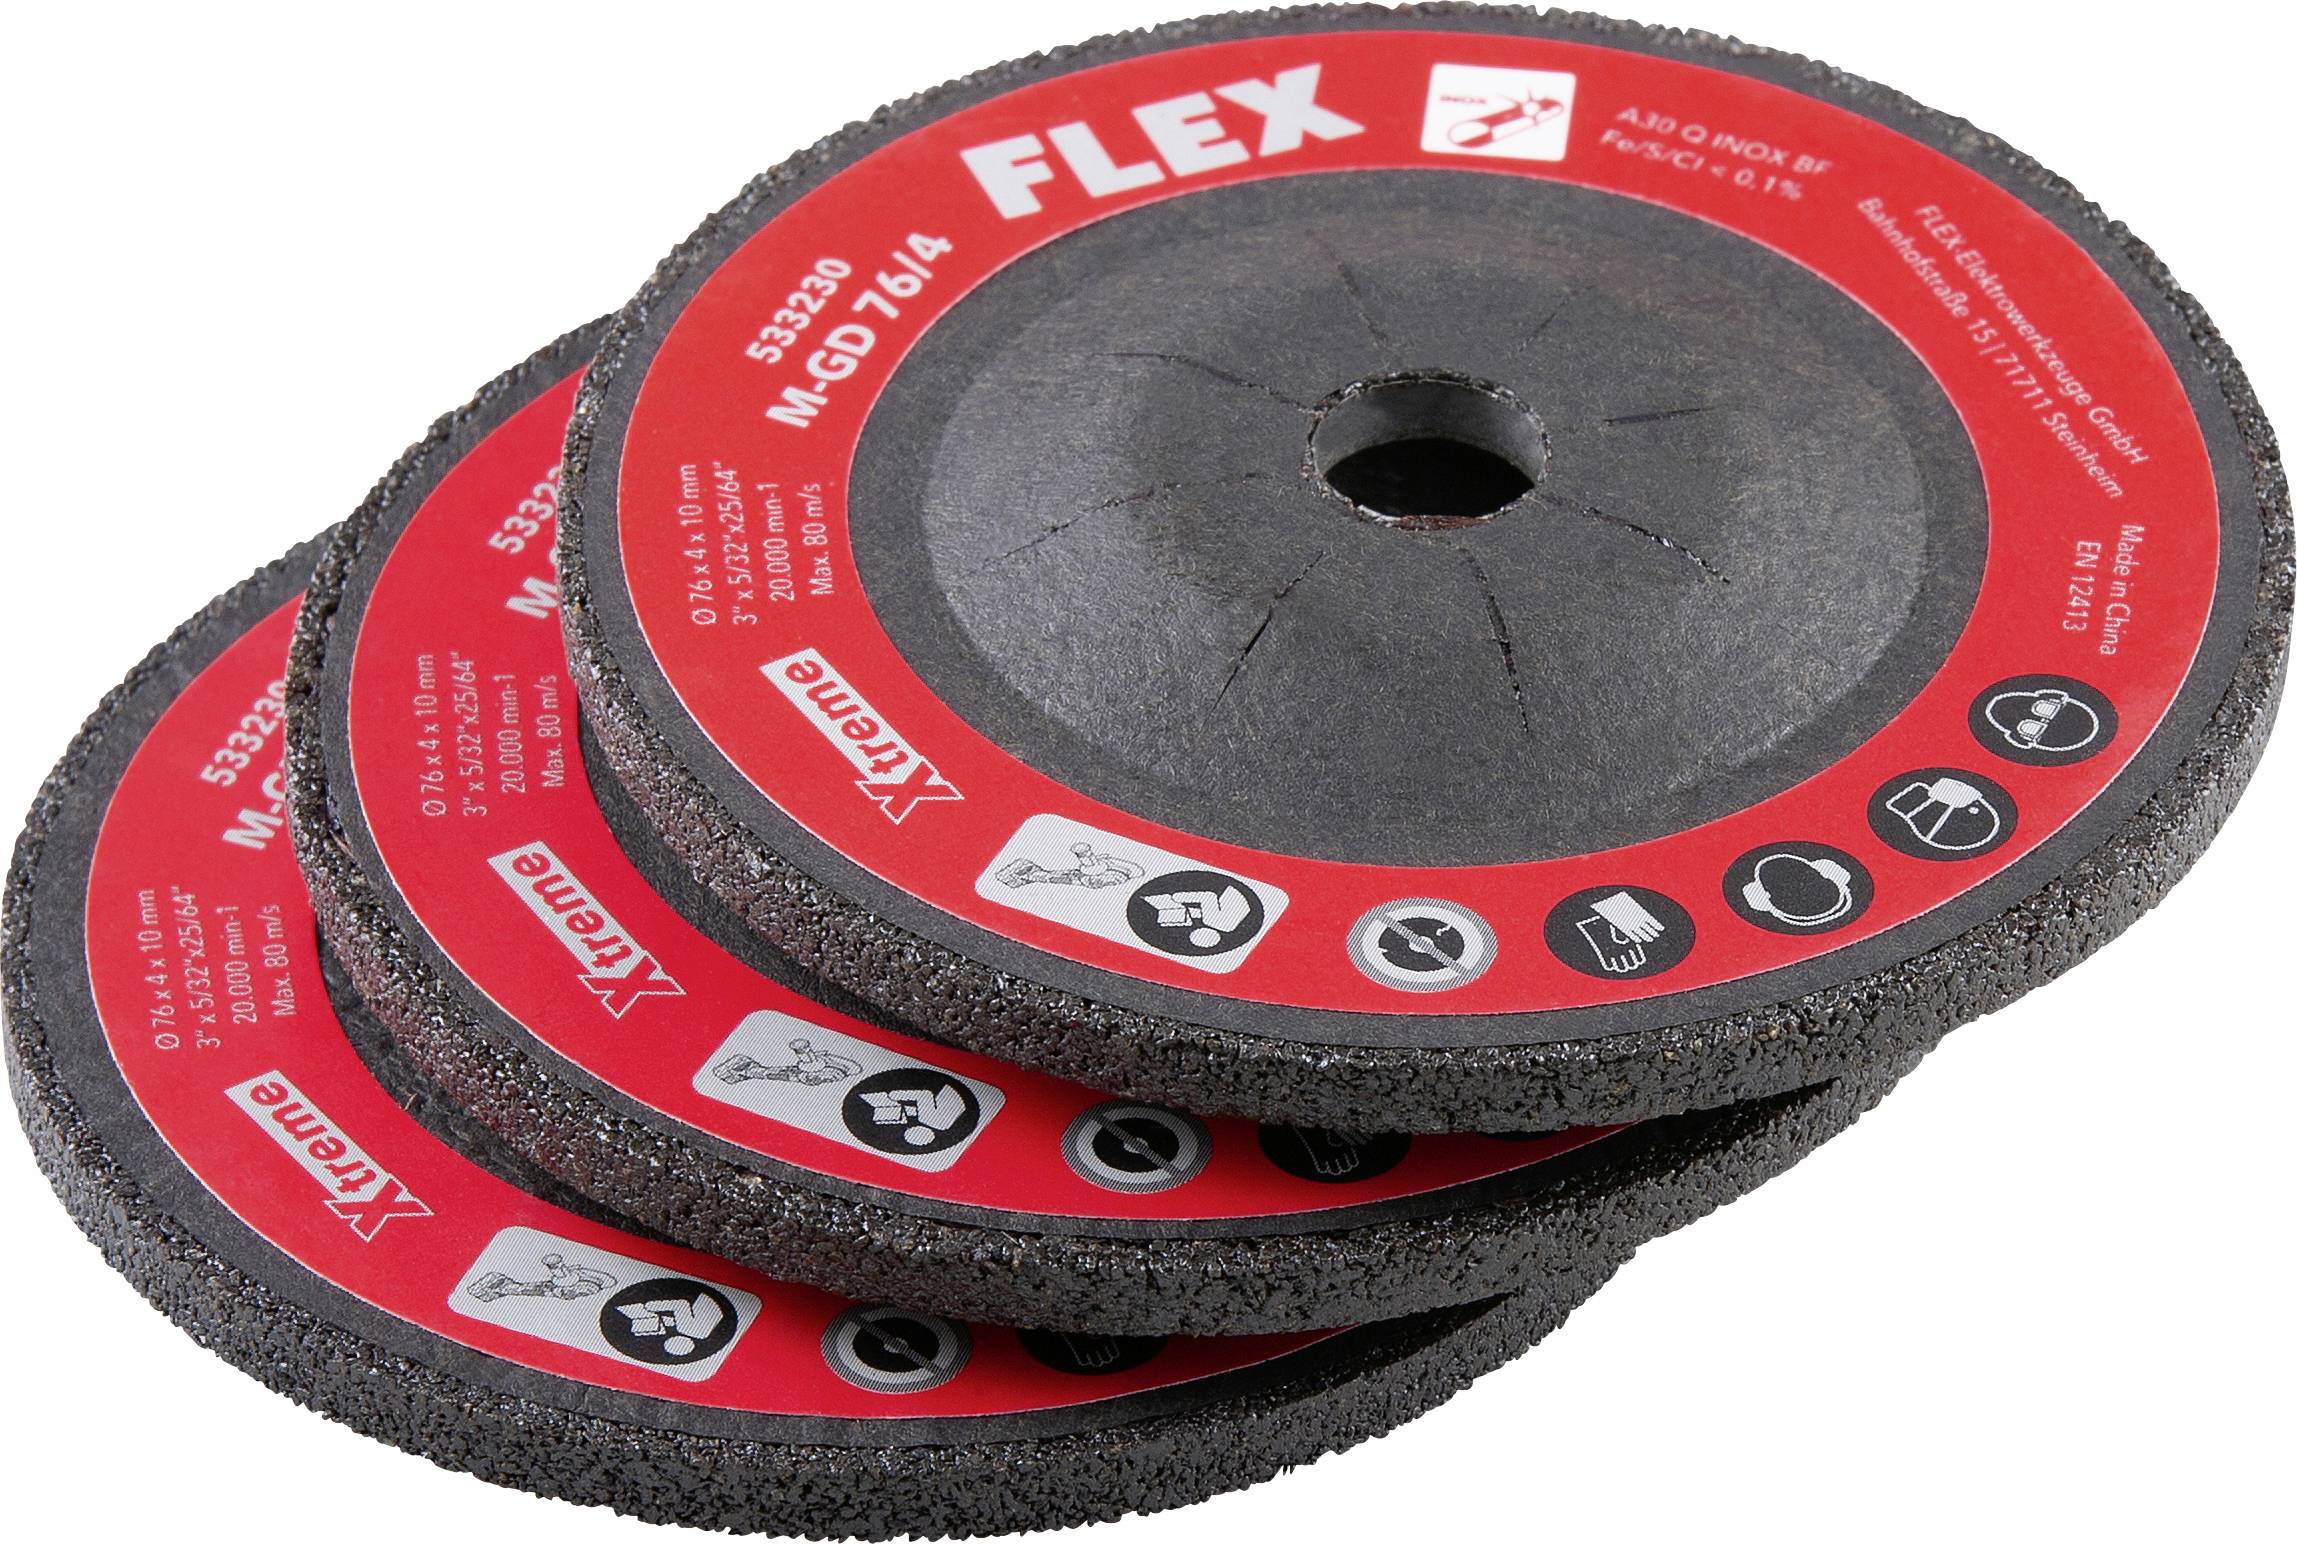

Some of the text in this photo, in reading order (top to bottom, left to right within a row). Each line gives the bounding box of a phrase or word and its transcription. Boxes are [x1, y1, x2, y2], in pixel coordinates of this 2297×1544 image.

[959, 62, 1366, 220] FLEX
[1615, 106, 1833, 176] A30 Q INOX BF
[744, 257, 853, 365] 533230
[765, 232, 954, 429] M-GD 76/4
[1856, 196, 1970, 318] Bahnhofstraße
[1967, 318, 1999, 344] 15
[1993, 351, 2054, 410] 71711
[2041, 411, 2124, 499] Steinheim
[1915, 204, 2150, 465] FLEX-Elektrowerkzeuge GmbH
[679, 463, 700, 499] mm
[677, 503, 704, 527] 10
[683, 547, 708, 560] 4
[689, 532, 706, 543] x
[755, 482, 796, 603] 20.000 min-1
[796, 482, 835, 596] Max. 80 m/s
[692, 563, 711, 575] x
[2061, 540, 2103, 632] EN 12413
[687, 579, 714, 604] 76
[736, 589, 754, 601] x
[2097, 523, 2146, 656] Made in China
[417, 654, 436, 690] mm
[412, 694, 438, 717] 10
[416, 737, 441, 751] 4
[423, 722, 440, 734] x
[492, 673, 527, 794] 20.000 min-1
[533, 674, 565, 788] Max. 80 m/s
[784, 658, 964, 825] Xtreme
[425, 754, 442, 766] x
[419, 769, 445, 795] 76
[468, 781, 485, 792] x
[137, 889, 159, 926] mm
[136, 929, 164, 953] 10
[511, 851, 687, 1019] Xtreme
[149, 957, 167, 969] x
[215, 905, 258, 1025] 20.000 min-1
[256, 904, 297, 1017] Max. 80 m/s
[144, 972, 169, 986] 4
[153, 989, 172, 1000] x
[149, 1004, 176, 1029] 76
[198, 1013, 217, 1024] x
[249, 1081, 435, 1242] Xtreme
